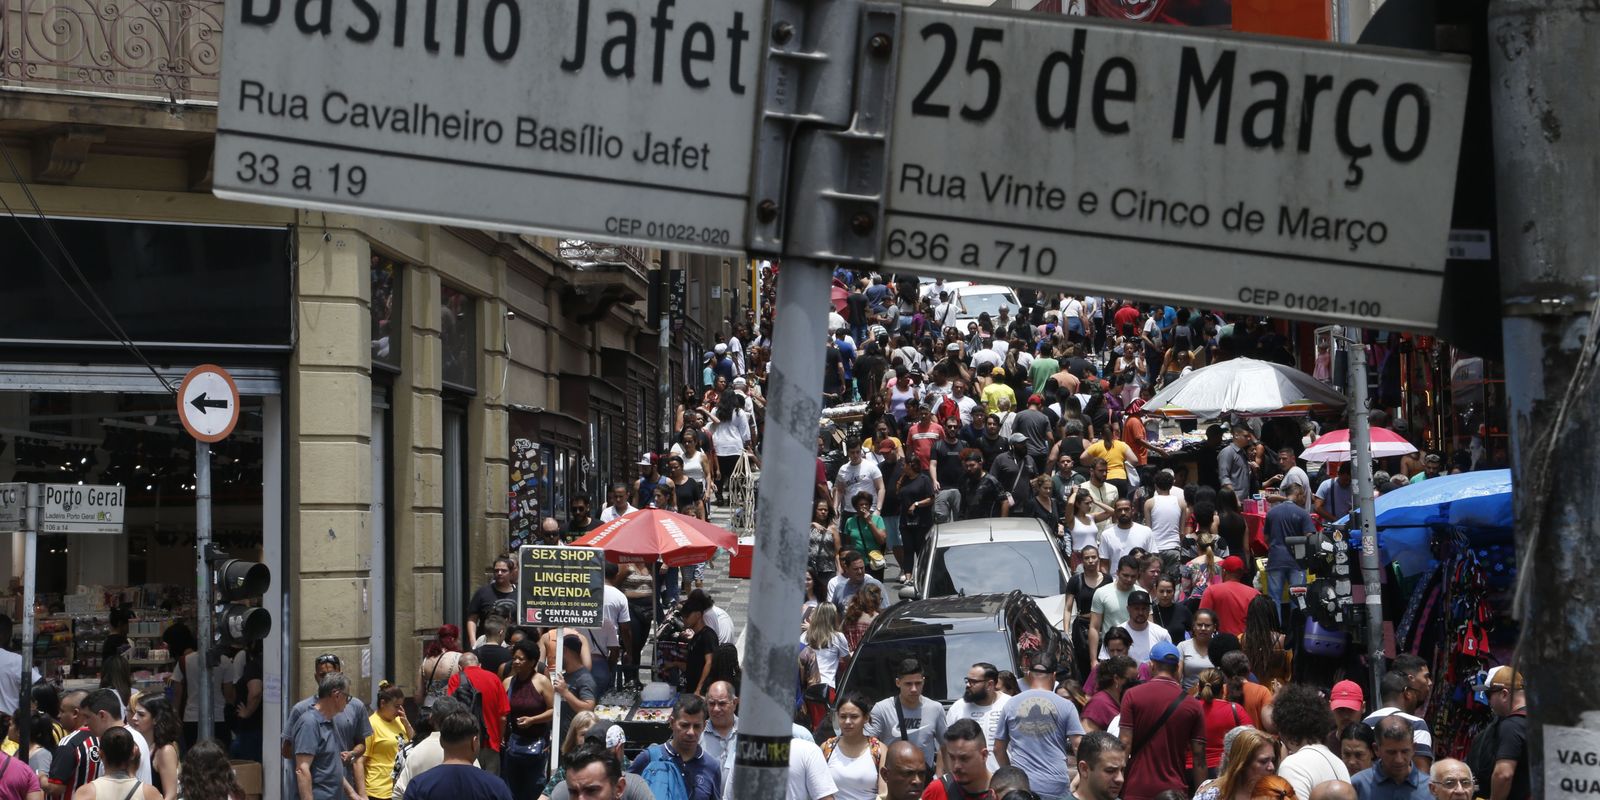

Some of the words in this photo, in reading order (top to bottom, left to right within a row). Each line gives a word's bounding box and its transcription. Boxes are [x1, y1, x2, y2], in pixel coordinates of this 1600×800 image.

[241, 0, 520, 61] aslio
[560, 0, 749, 94] Jafet
[912, 22, 1003, 121] 25
[1036, 29, 1137, 134] de
[1172, 46, 1431, 187] Março
[239, 80, 308, 120] Rua
[322, 91, 503, 145] Cavalheiro
[515, 116, 623, 159] Basílio
[633, 131, 710, 171] Jafet
[236, 151, 279, 185] 33
[292, 165, 311, 190] a
[328, 163, 367, 196] 19
[900, 163, 966, 199] Rua
[981, 172, 1066, 211] Vinte
[1078, 191, 1098, 214] e
[1111, 188, 1210, 228] Cinco
[1222, 202, 1265, 233] de
[1278, 206, 1388, 250] Março
[605, 217, 641, 234] CEP
[647, 222, 730, 245] 01022-020
[887, 229, 949, 262] 636
[960, 243, 980, 267] a
[995, 241, 1057, 276] 710
[1238, 287, 1280, 306] CEP
[1285, 294, 1381, 318] 01021-100
[0, 488, 17, 508] ço
[46, 487, 82, 505] Porto
[88, 488, 123, 507] Geral
[66, 512, 80, 520] Porto
[532, 548, 557, 560] SEX
[560, 550, 595, 561] SHOP
[534, 572, 591, 584] LINGERIE
[533, 586, 592, 598] REVENDA
[544, 608, 580, 616] CENTRAL
[548, 616, 594, 624] CALCINHAS
[1557, 749, 1600, 766] VAG
